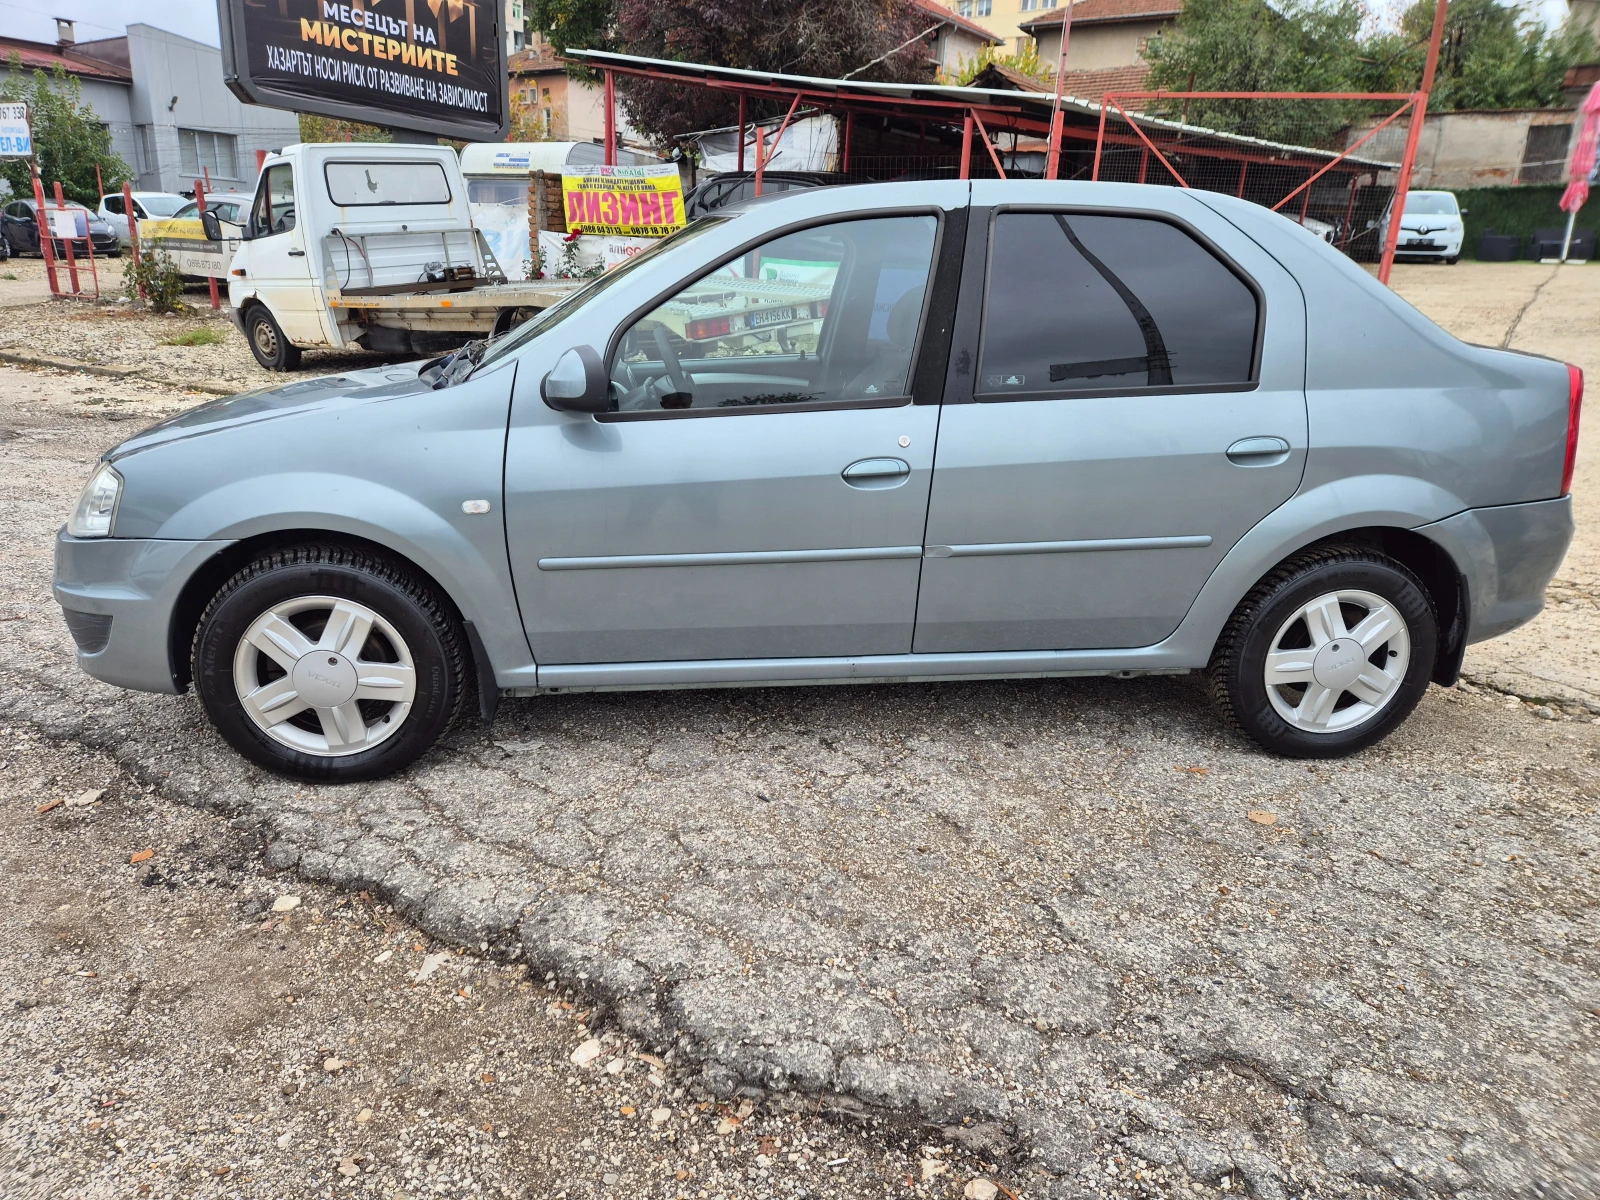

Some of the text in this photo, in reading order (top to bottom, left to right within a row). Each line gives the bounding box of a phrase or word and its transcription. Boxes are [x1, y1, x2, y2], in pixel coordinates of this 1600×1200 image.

[323, 0, 437, 45] МЕСЕЦЪТ НА
[300, 17, 459, 76] МИСТЕРИИТЕ
[266, 44, 488, 113] ХАЗАРТЪТ НОСИ РИСК ОТ РАЗВИВАНЕ НА ЗАВИСИМОСТ
[0, 136, 30, 153] ЕЛ-ВИ
[567, 190, 679, 226] ЛИЗИНГ
